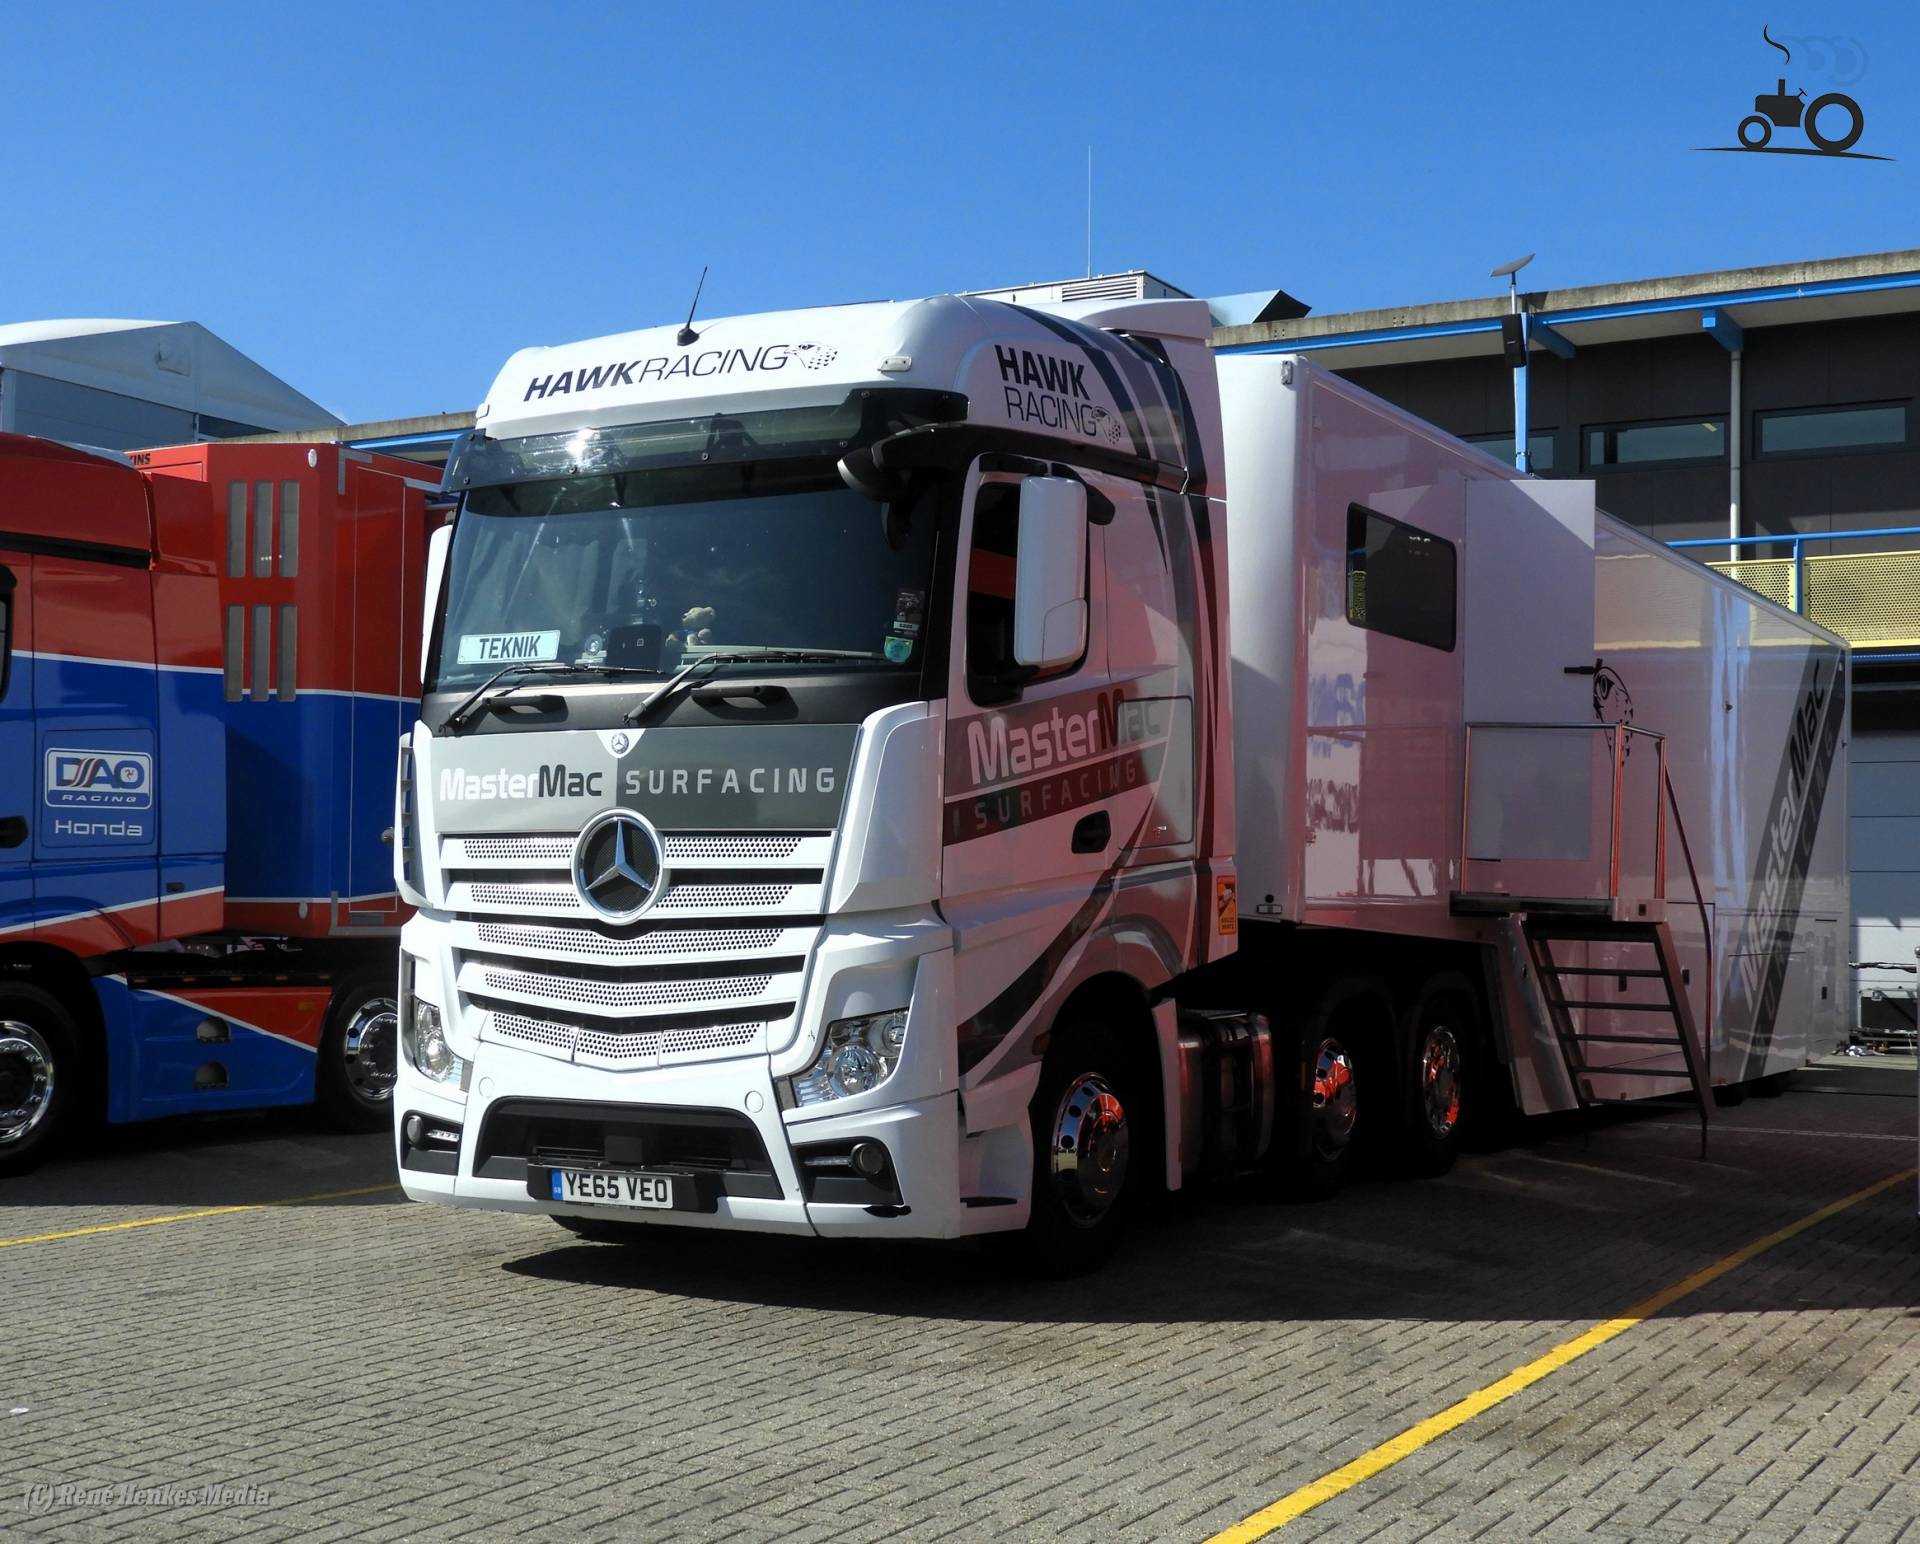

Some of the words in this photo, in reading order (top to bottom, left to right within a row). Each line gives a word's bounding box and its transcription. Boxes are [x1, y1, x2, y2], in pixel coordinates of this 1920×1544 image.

[994, 344, 1090, 400] HAWK
[1004, 386, 1098, 437] RACING
[478, 636, 542, 660] TEKNIK
[62, 794, 138, 803] RACING
[440, 764, 603, 801] MasterMac
[625, 767, 836, 797] SURFACING
[974, 758, 1136, 831] SURFACING
[55, 820, 143, 837] Honda
[565, 1172, 620, 1200] YE65
[625, 1176, 669, 1203] VEO
